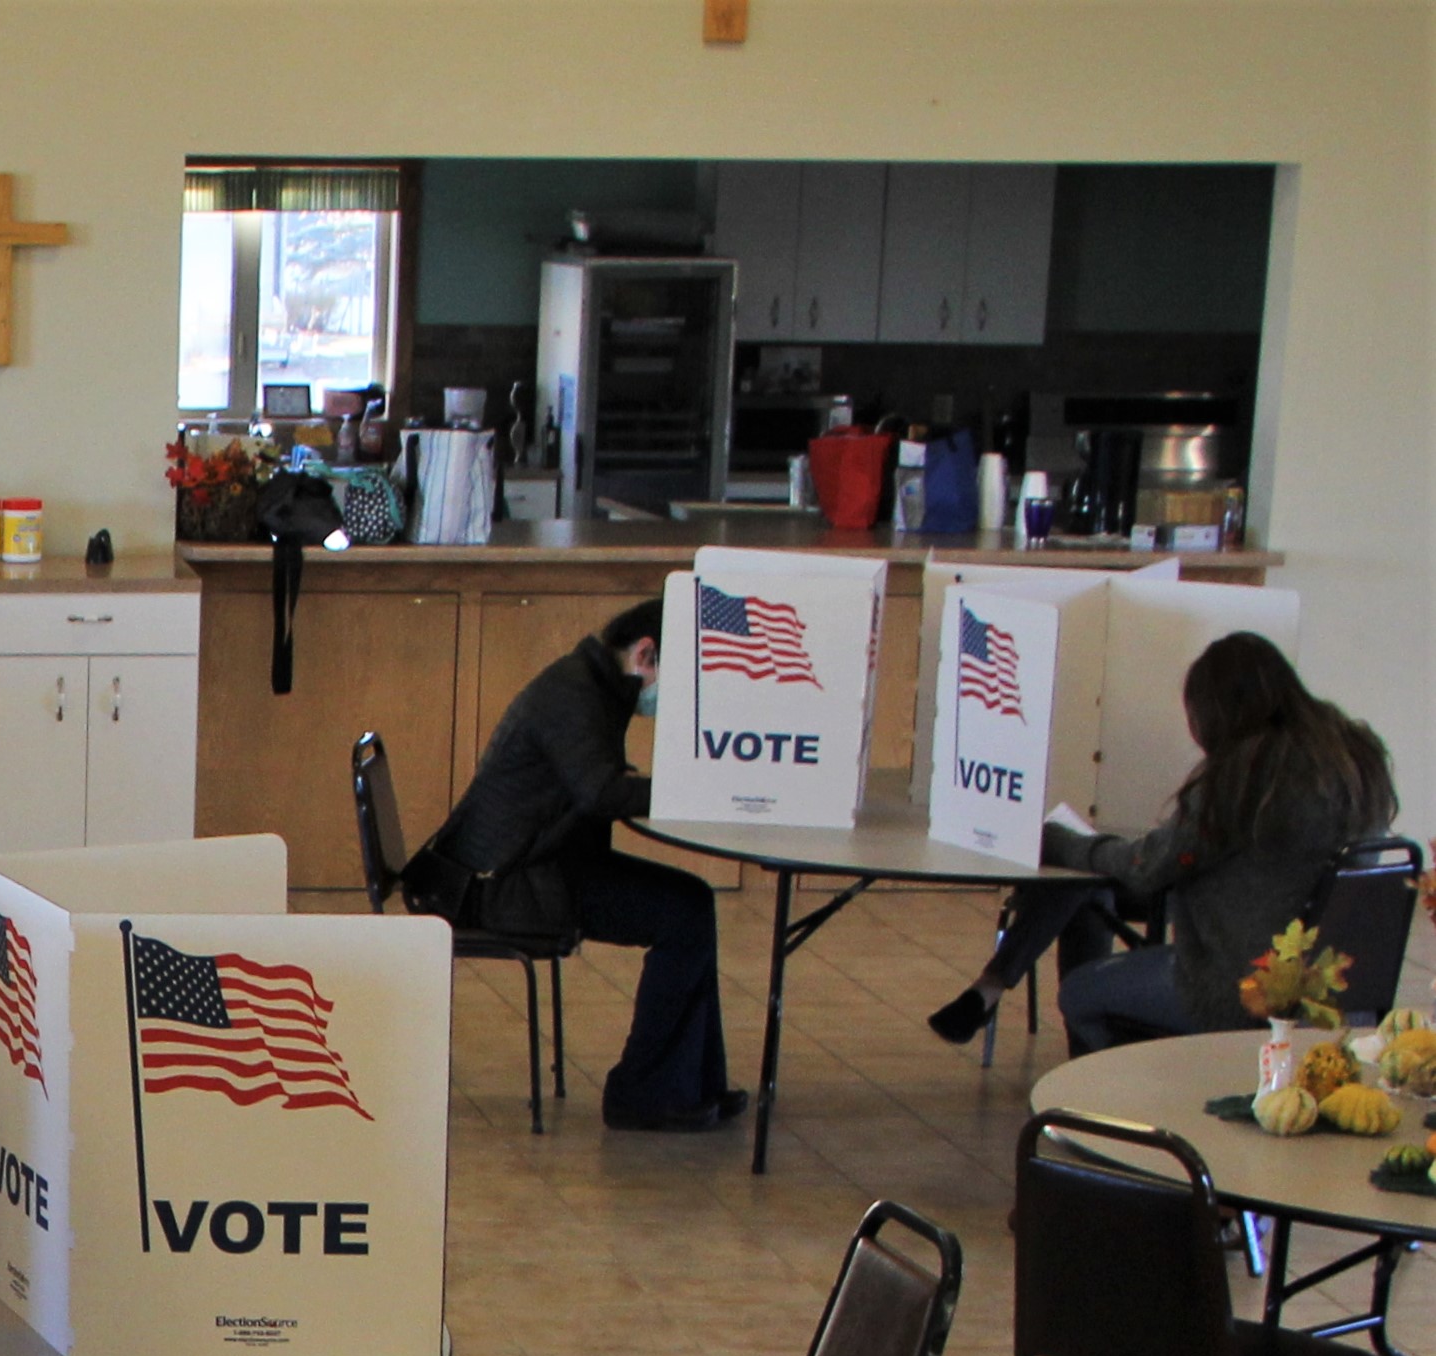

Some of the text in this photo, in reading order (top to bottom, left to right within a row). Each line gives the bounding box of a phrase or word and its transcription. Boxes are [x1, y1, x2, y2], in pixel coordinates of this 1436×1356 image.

[702, 730, 820, 764] VOTE
[959, 757, 1023, 803] VOTE
[153, 1200, 369, 1255] VOTE
[215, 1316, 298, 1328] ElectionSource
